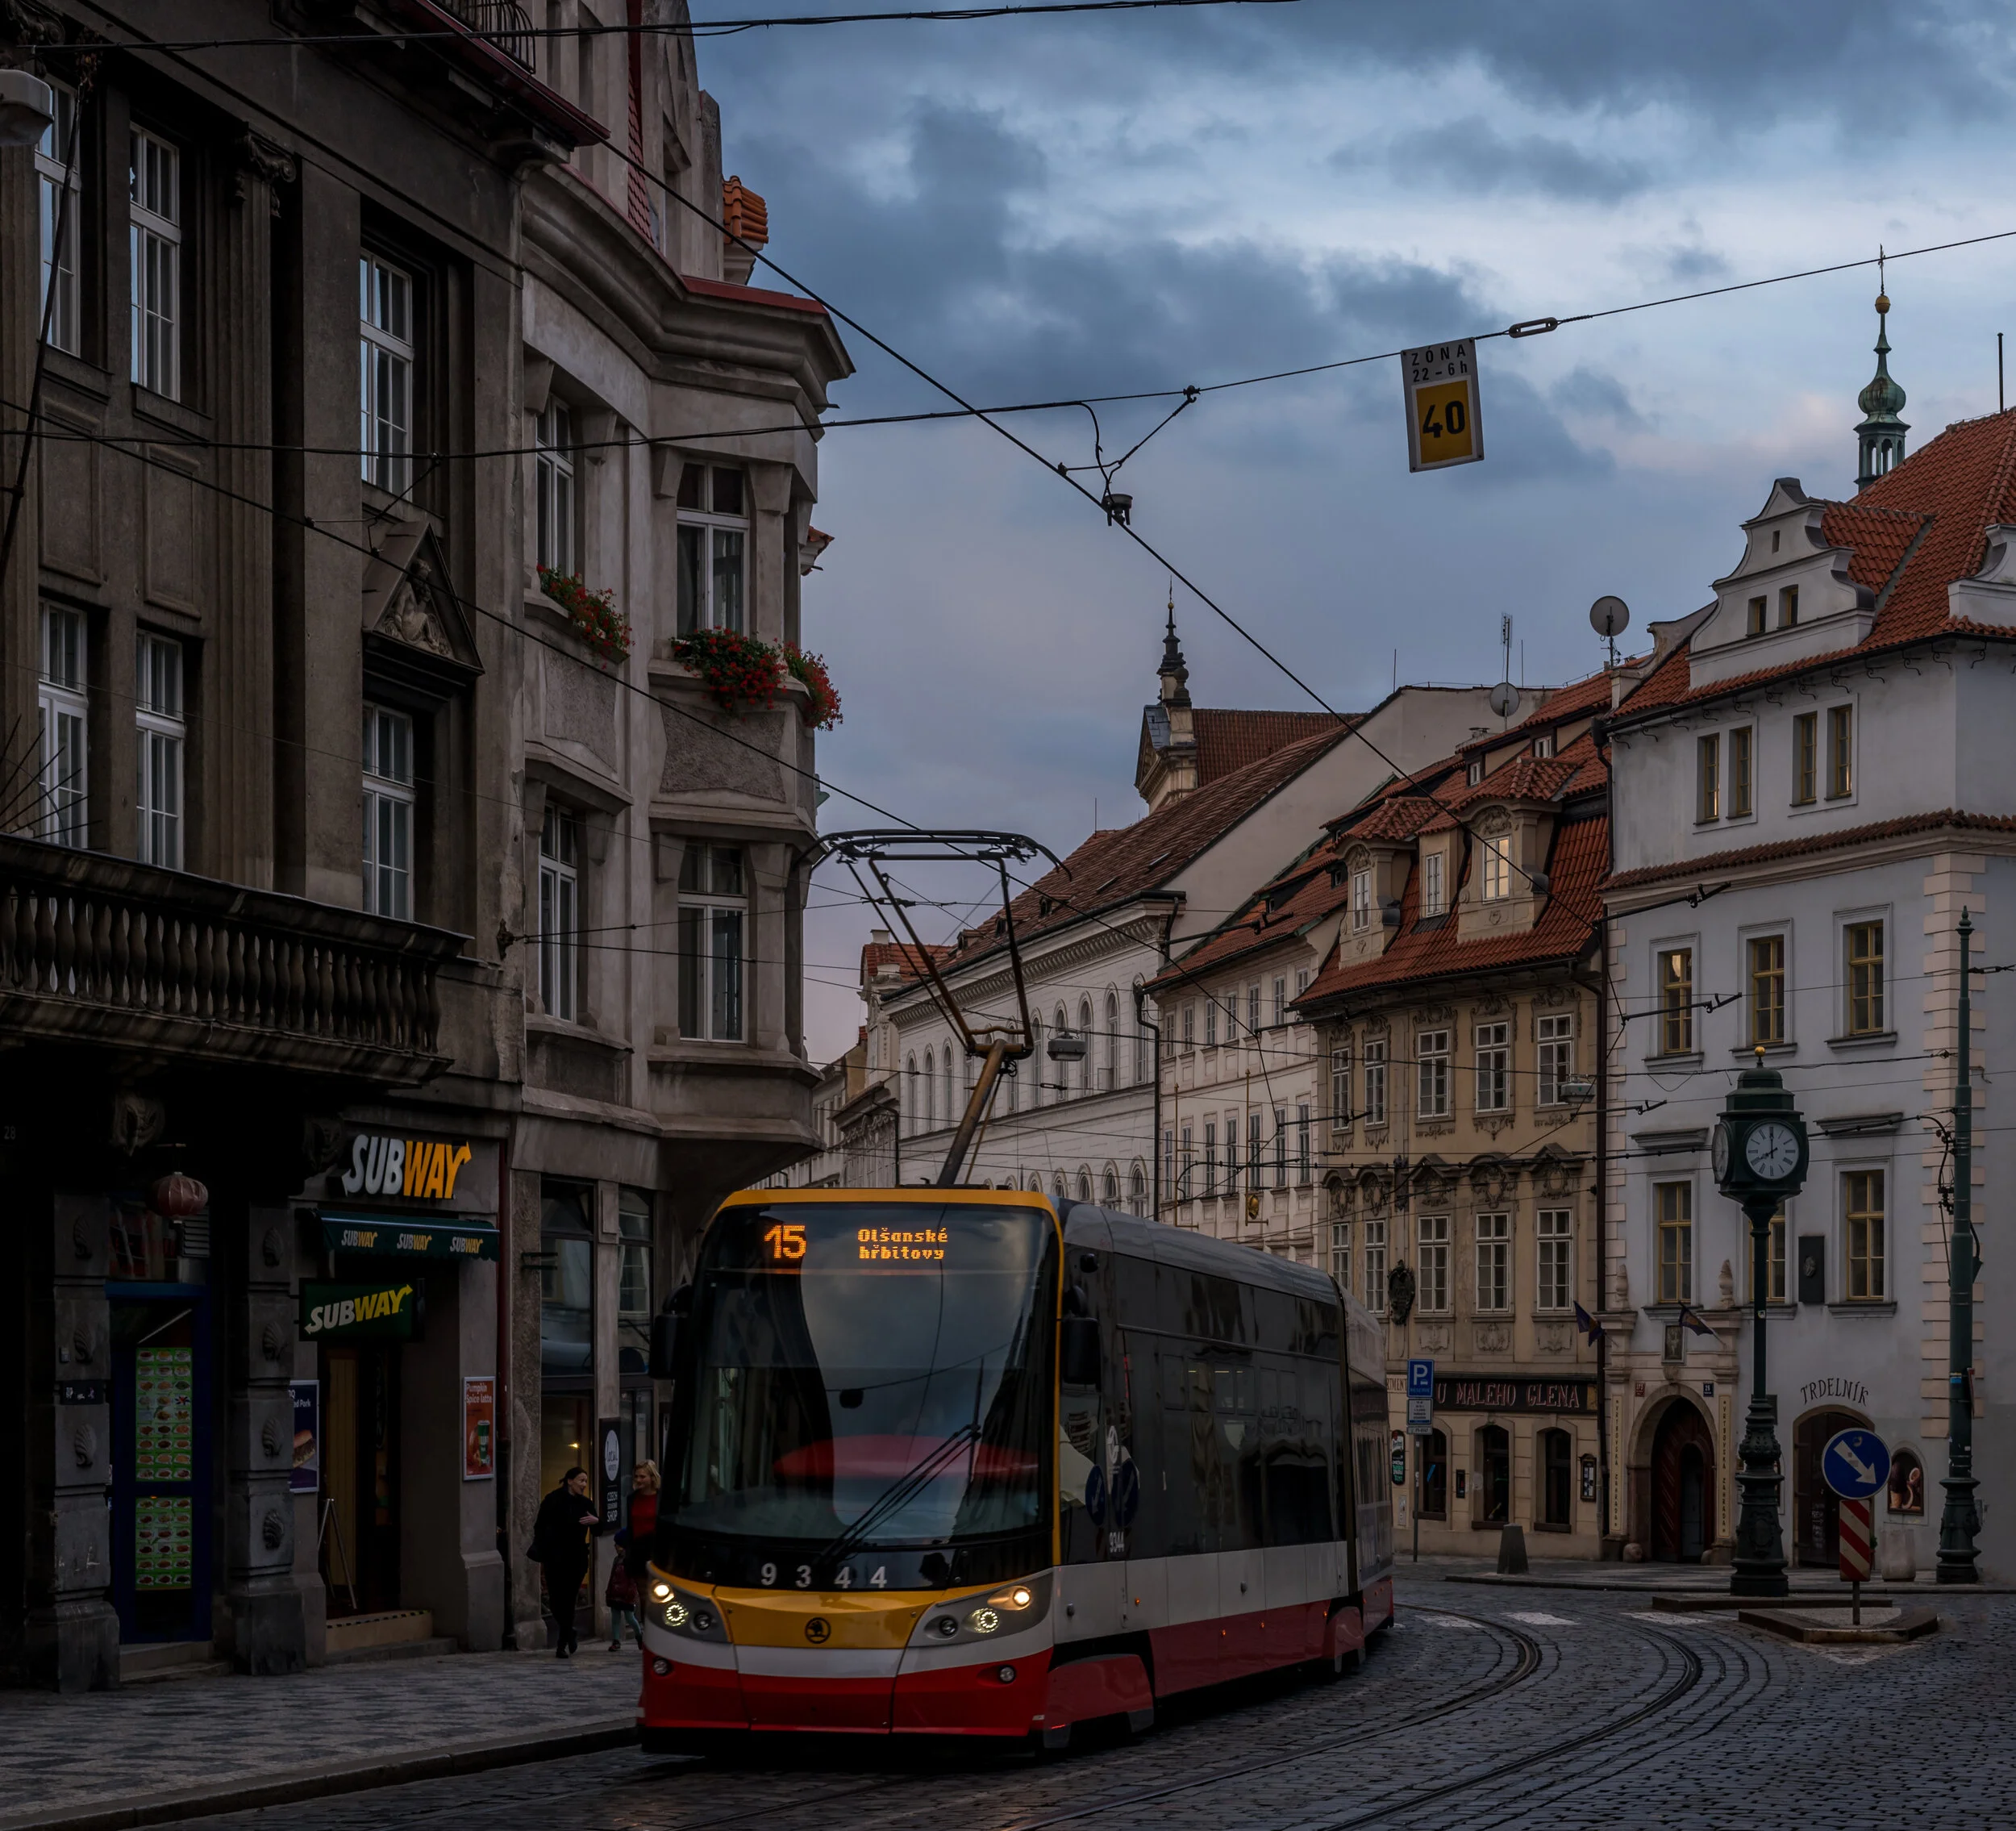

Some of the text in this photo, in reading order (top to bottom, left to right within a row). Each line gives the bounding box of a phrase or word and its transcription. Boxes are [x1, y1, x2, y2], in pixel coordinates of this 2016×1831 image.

[1411, 344, 1466, 366] ZÓNA
[1422, 400, 1465, 438] 40
[342, 1134, 472, 1199] SUBWAY
[341, 1229, 483, 1254] SUBWAY SUBWAY SUBWAY
[764, 1224, 806, 1258] 15
[857, 1228, 948, 1242] Olšanské
[859, 1245, 944, 1259] hřbitovy
[304, 1284, 413, 1334] SUBWAY
[1526, 1383, 1581, 1408] GLENA
[1800, 1378, 1869, 1407] TRDELNÍK
[1110, 1532, 1125, 1553] 9344
[760, 1562, 887, 1589] 9344
